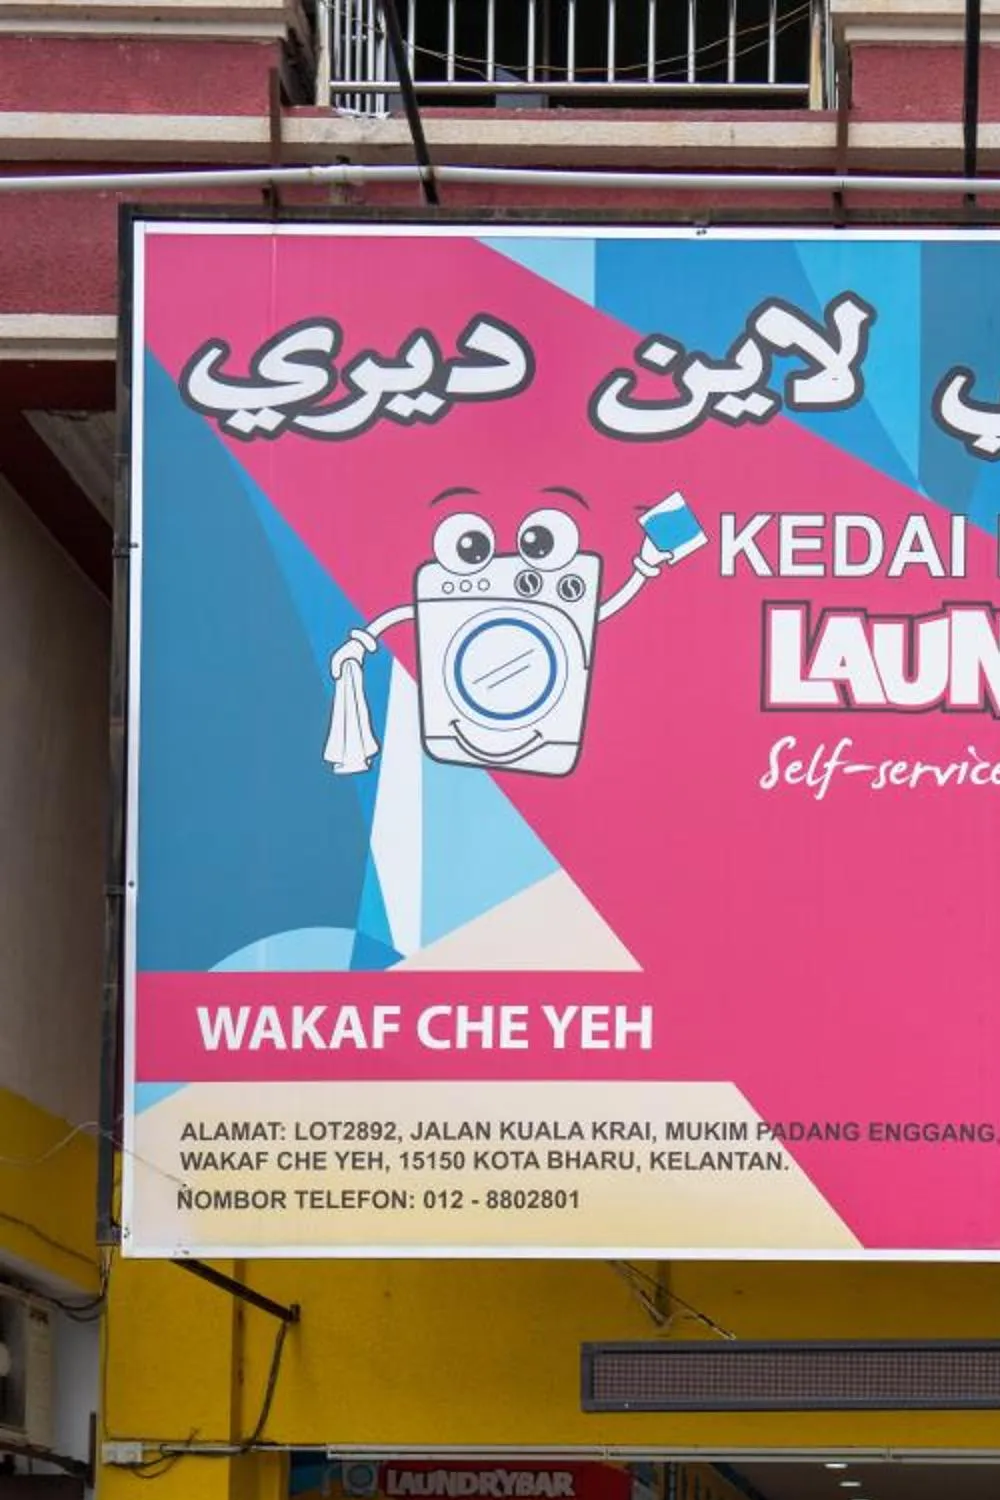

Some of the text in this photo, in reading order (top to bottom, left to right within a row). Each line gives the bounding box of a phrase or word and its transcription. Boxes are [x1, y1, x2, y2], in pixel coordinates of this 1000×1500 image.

[179, 312, 535, 443] ديري
[587, 290, 877, 443] لاين
[719, 512, 968, 578] KEDAI
[196, 1004, 653, 1052] WAKAF CHE YEH
[180, 1120, 286, 1142] ALAMAT:
[294, 1120, 403, 1144] LOT2892,
[410, 1120, 492, 1142] JALAN
[499, 1120, 585, 1142] KUALA
[592, 1121, 657, 1144] KRAI,
[665, 1121, 749, 1142] MUKIM
[756, 1121, 861, 1143] PADANG
[180, 1150, 790, 1174] WAKAF CHE YEH, 15150 KOTA BHARU, KELANTAN.
[177, 1189, 287, 1210] NOMBOR
[294, 1189, 415, 1210] TELEFON:
[422, 1190, 464, 1209] 012
[486, 1189, 581, 1209] 8802801
[386, 1468, 576, 1498] LAUNDRYBAR
